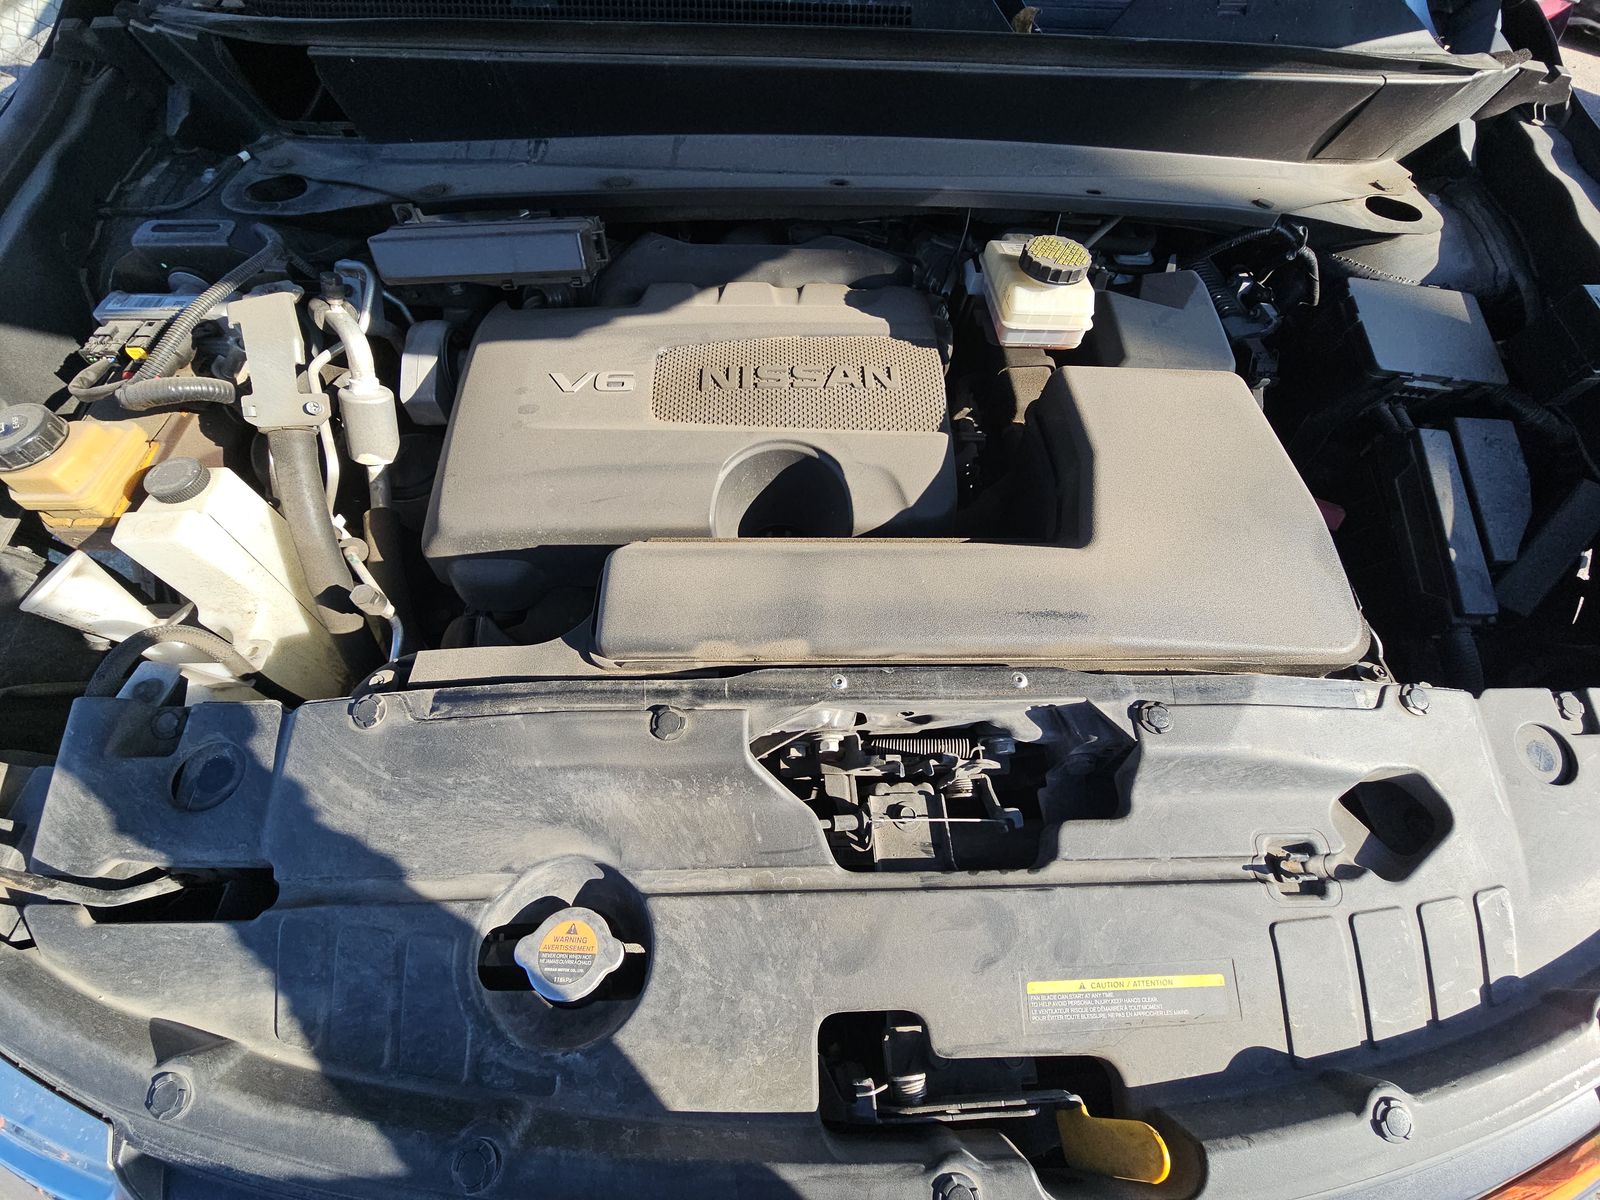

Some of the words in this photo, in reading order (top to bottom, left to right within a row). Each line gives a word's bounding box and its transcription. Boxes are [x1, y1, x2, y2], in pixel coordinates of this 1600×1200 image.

[549, 370, 635, 394] V6
[699, 364, 902, 392] NISSAN
[543, 944, 594, 952] AVERTISSEMENT
[1090, 981, 1125, 989] CAUTION
[1132, 979, 1173, 987] ATTENTION
